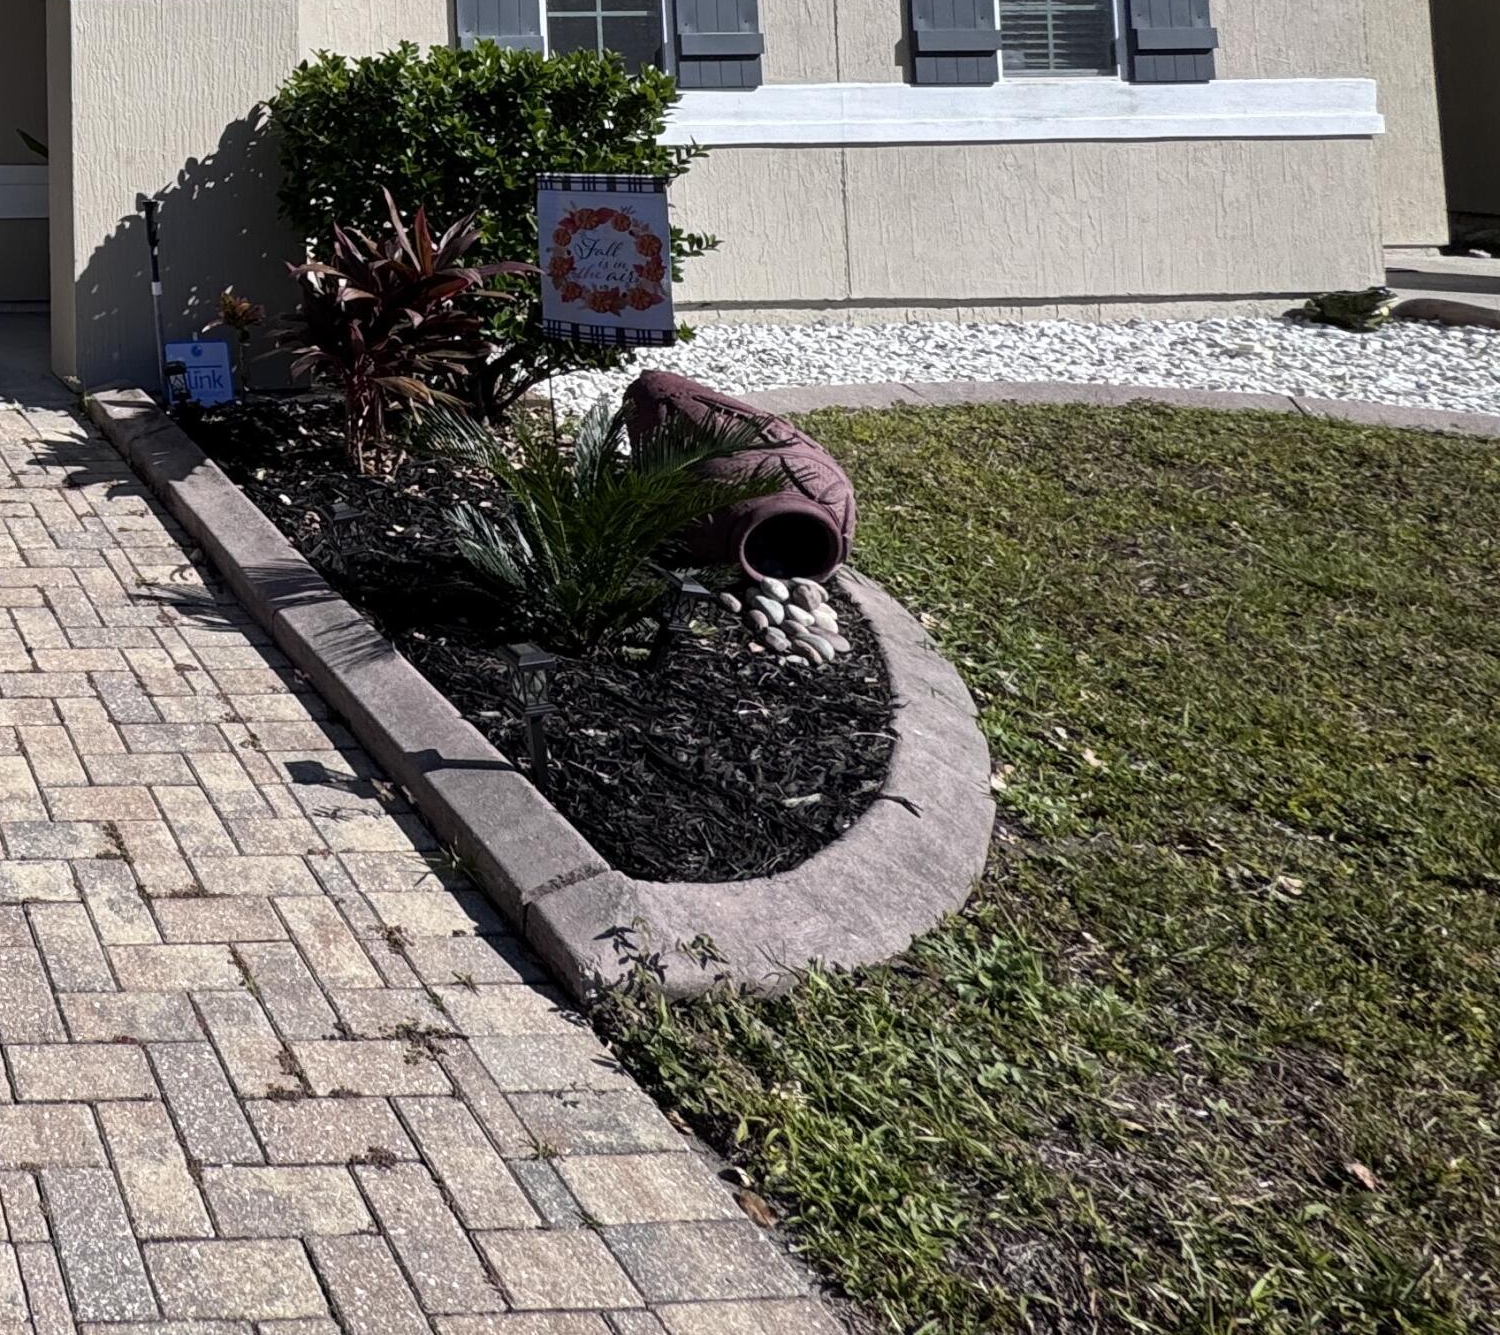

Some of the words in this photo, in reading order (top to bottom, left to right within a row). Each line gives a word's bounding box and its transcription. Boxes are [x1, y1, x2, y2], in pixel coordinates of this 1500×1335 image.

[574, 238, 623, 260] Fall
[571, 264, 603, 280] the
[606, 269, 639, 283] air
[598, 258, 609, 270] is
[186, 369, 224, 390] link
